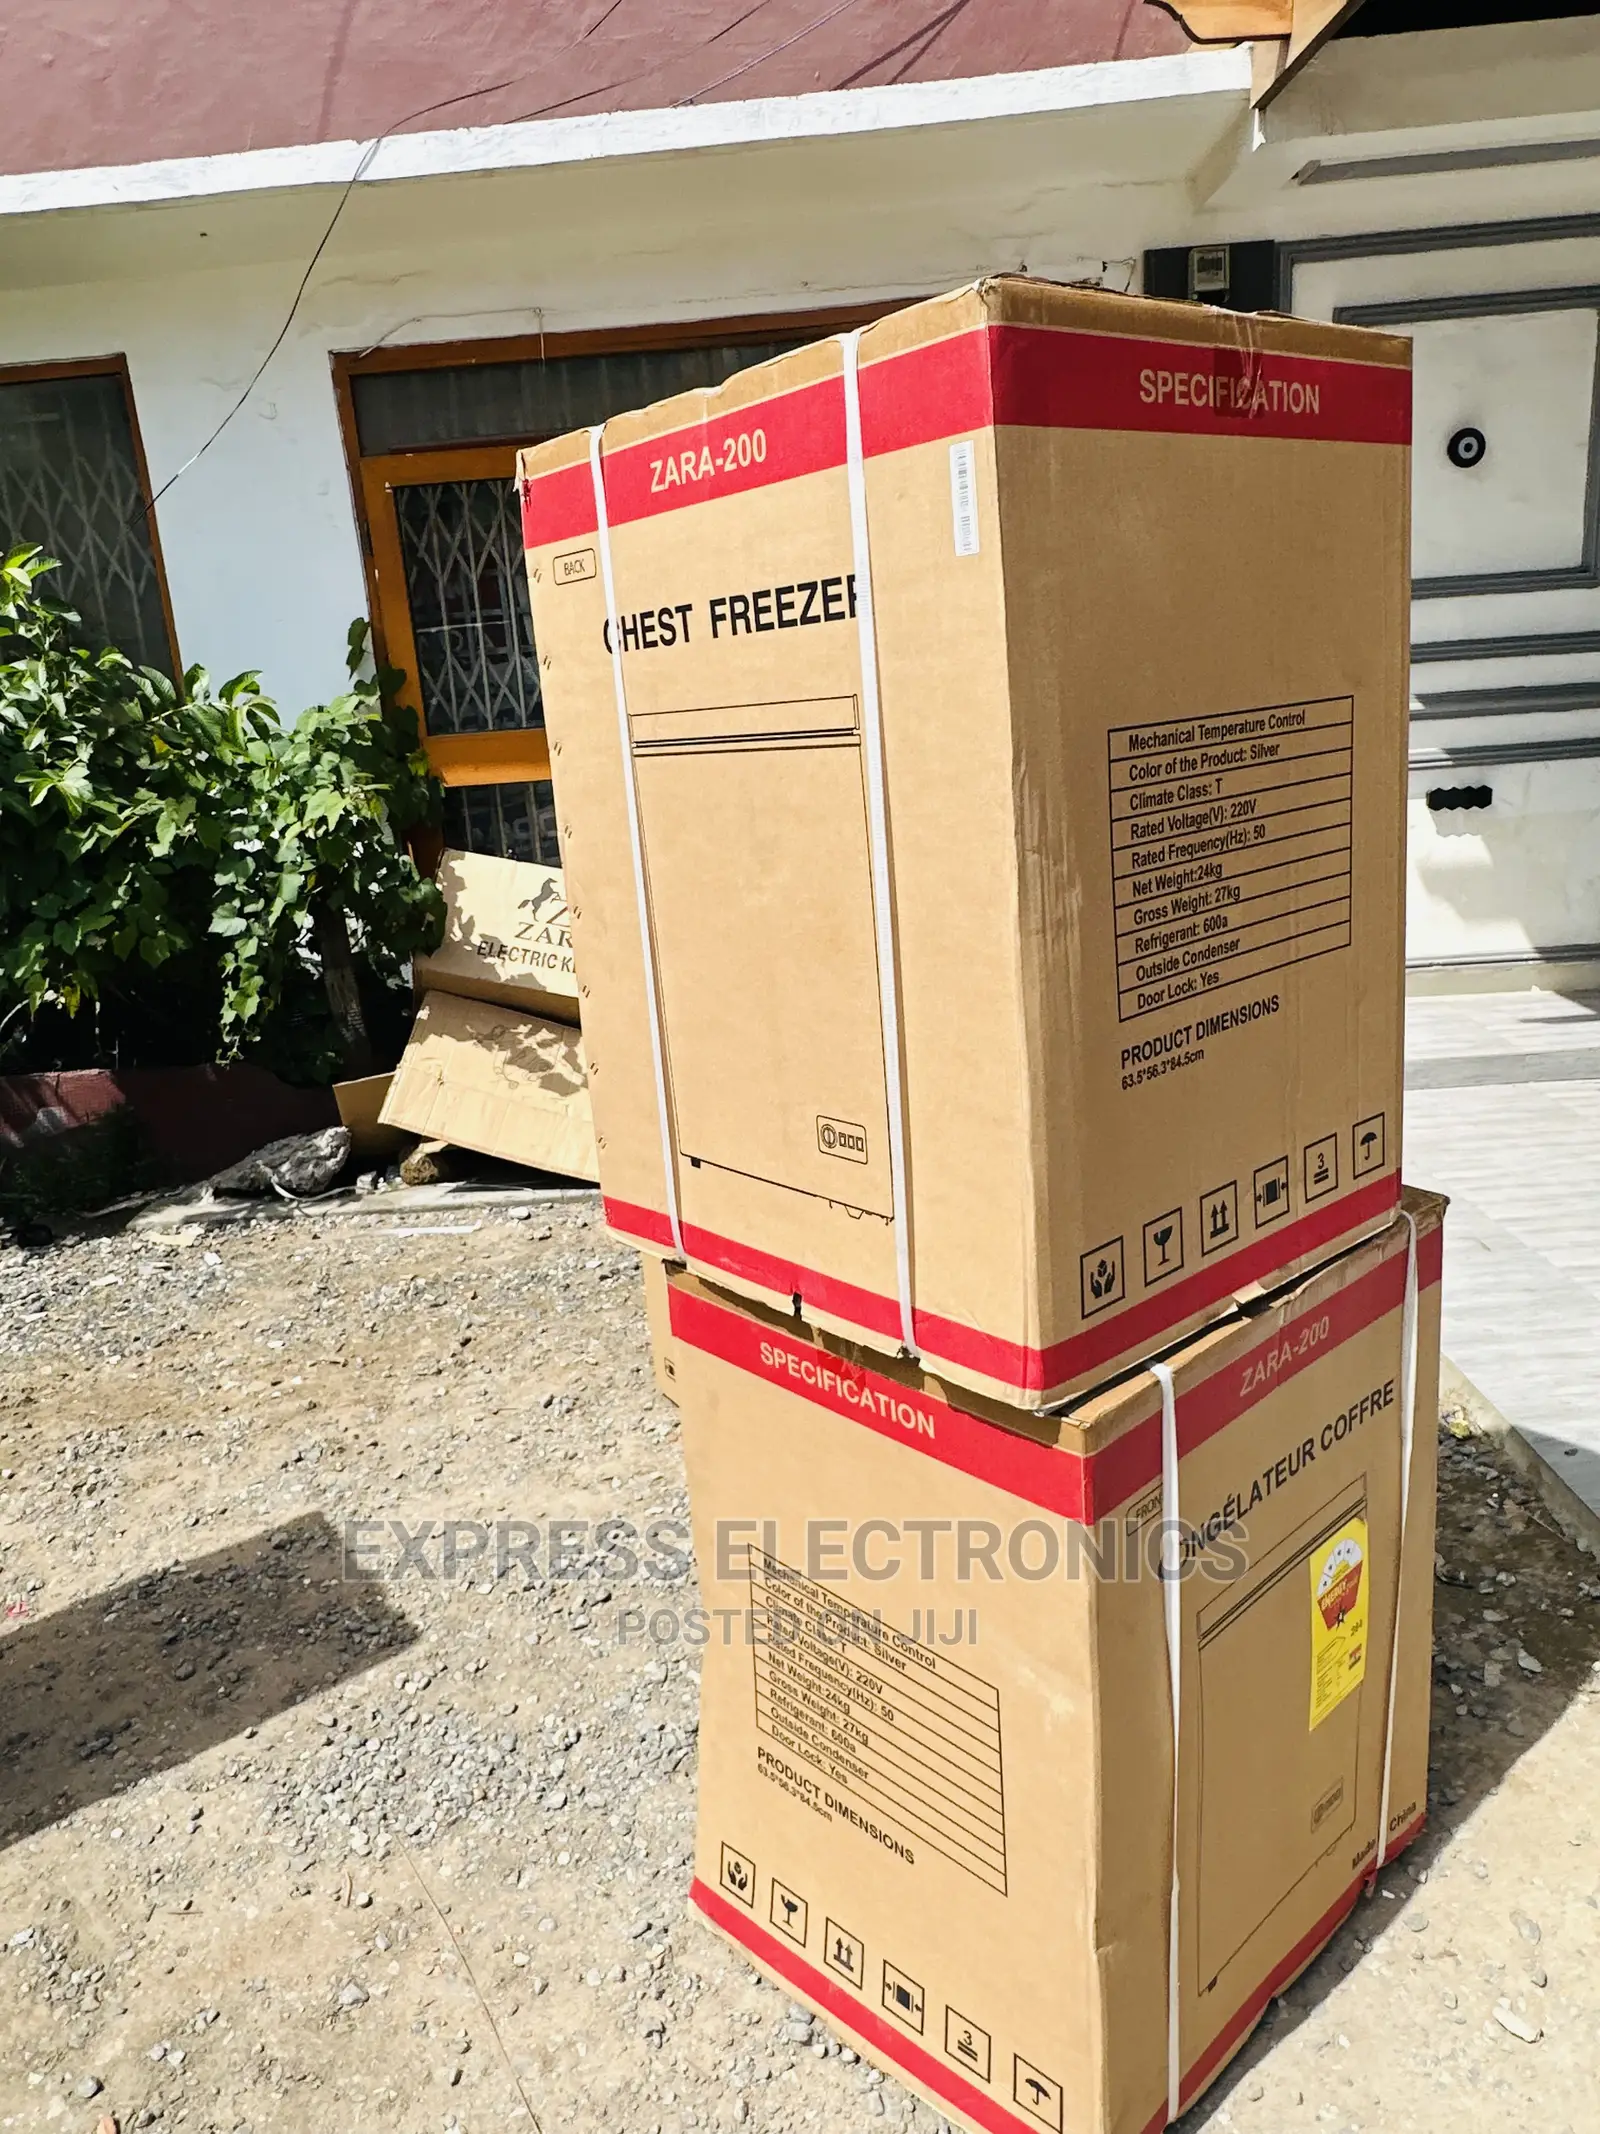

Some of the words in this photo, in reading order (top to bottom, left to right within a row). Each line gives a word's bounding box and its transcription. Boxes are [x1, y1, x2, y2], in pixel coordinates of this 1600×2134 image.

[1139, 369, 1320, 414] SPECIFICATION
[649, 428, 767, 492] ZARA-200
[563, 557, 585, 575] BACK
[1128, 726, 1195, 752] Mechanical
[1198, 718, 1265, 741] Temperature
[1268, 709, 1305, 729] Control
[1129, 761, 1162, 782] Color
[1165, 759, 1177, 774] of
[1179, 756, 1198, 772] the
[1200, 750, 1247, 769] Product:
[1250, 742, 1280, 760] Silver
[1130, 788, 1174, 811] Climate
[1177, 783, 1213, 801] Class:
[1215, 778, 1223, 794] T
[1131, 818, 1164, 840] Rated
[1167, 807, 1228, 833] Voltage(V):
[1230, 799, 1257, 818] 220V
[1131, 847, 1165, 869] Rated
[1168, 829, 1250, 861] Frequency(Hz):
[1253, 824, 1266, 841] 50
[1132, 879, 1153, 898] Net
[1134, 904, 1168, 926] Gross
[1171, 891, 1213, 915] Weight:
[1215, 885, 1241, 904] 27kg
[477, 941, 558, 969] ELECTRIC
[514, 921, 573, 948] ZAR
[1135, 922, 1200, 954] Refrigerant:
[1203, 914, 1228, 932] 600a
[1136, 959, 1180, 982] Outside
[1182, 938, 1240, 967] Condenser
[1137, 989, 1164, 1010] Door
[1168, 978, 1197, 999] Lock:
[1200, 970, 1220, 988] Yes
[1121, 1026, 1192, 1070] PRODUCT
[1196, 995, 1280, 1041] DIMENSIONS
[1240, 1315, 1329, 1398] ZARA-200
[759, 1341, 936, 1439] SPECIFICATION
[1320, 1379, 1395, 1452] COFFRE
[1135, 1492, 1163, 1519] FRON
[764, 1558, 818, 1599] Mechanical
[821, 1592, 888, 1640] Temperature
[892, 1635, 935, 1669] Control
[765, 1577, 791, 1601] Color
[794, 1597, 803, 1609] of
[806, 1602, 822, 1620] the
[874, 1643, 906, 1671] Silver
[766, 1595, 802, 1626] Climate
[841, 1642, 847, 1653] T
[767, 1613, 795, 1640] Rated
[798, 1635, 853, 1677] Voltage(V):
[856, 1670, 883, 1694] 220V
[768, 1651, 785, 1670] Net
[769, 1670, 798, 1697] Gross
[801, 1690, 840, 1723] Weight:
[843, 1718, 869, 1747] 27kg
[770, 1688, 828, 1735] Refrigerant:
[881, 1705, 894, 1721] 50
[771, 1706, 809, 1740] Outside
[811, 1734, 869, 1780] Condenser
[772, 1724, 795, 1748] Door
[798, 1743, 826, 1769] Lock:
[829, 1763, 848, 1784] Yes
[758, 1746, 821, 1799] PRODUCT
[825, 1792, 915, 1865] DIMENSIONS
[1389, 1801, 1417, 1832] China
